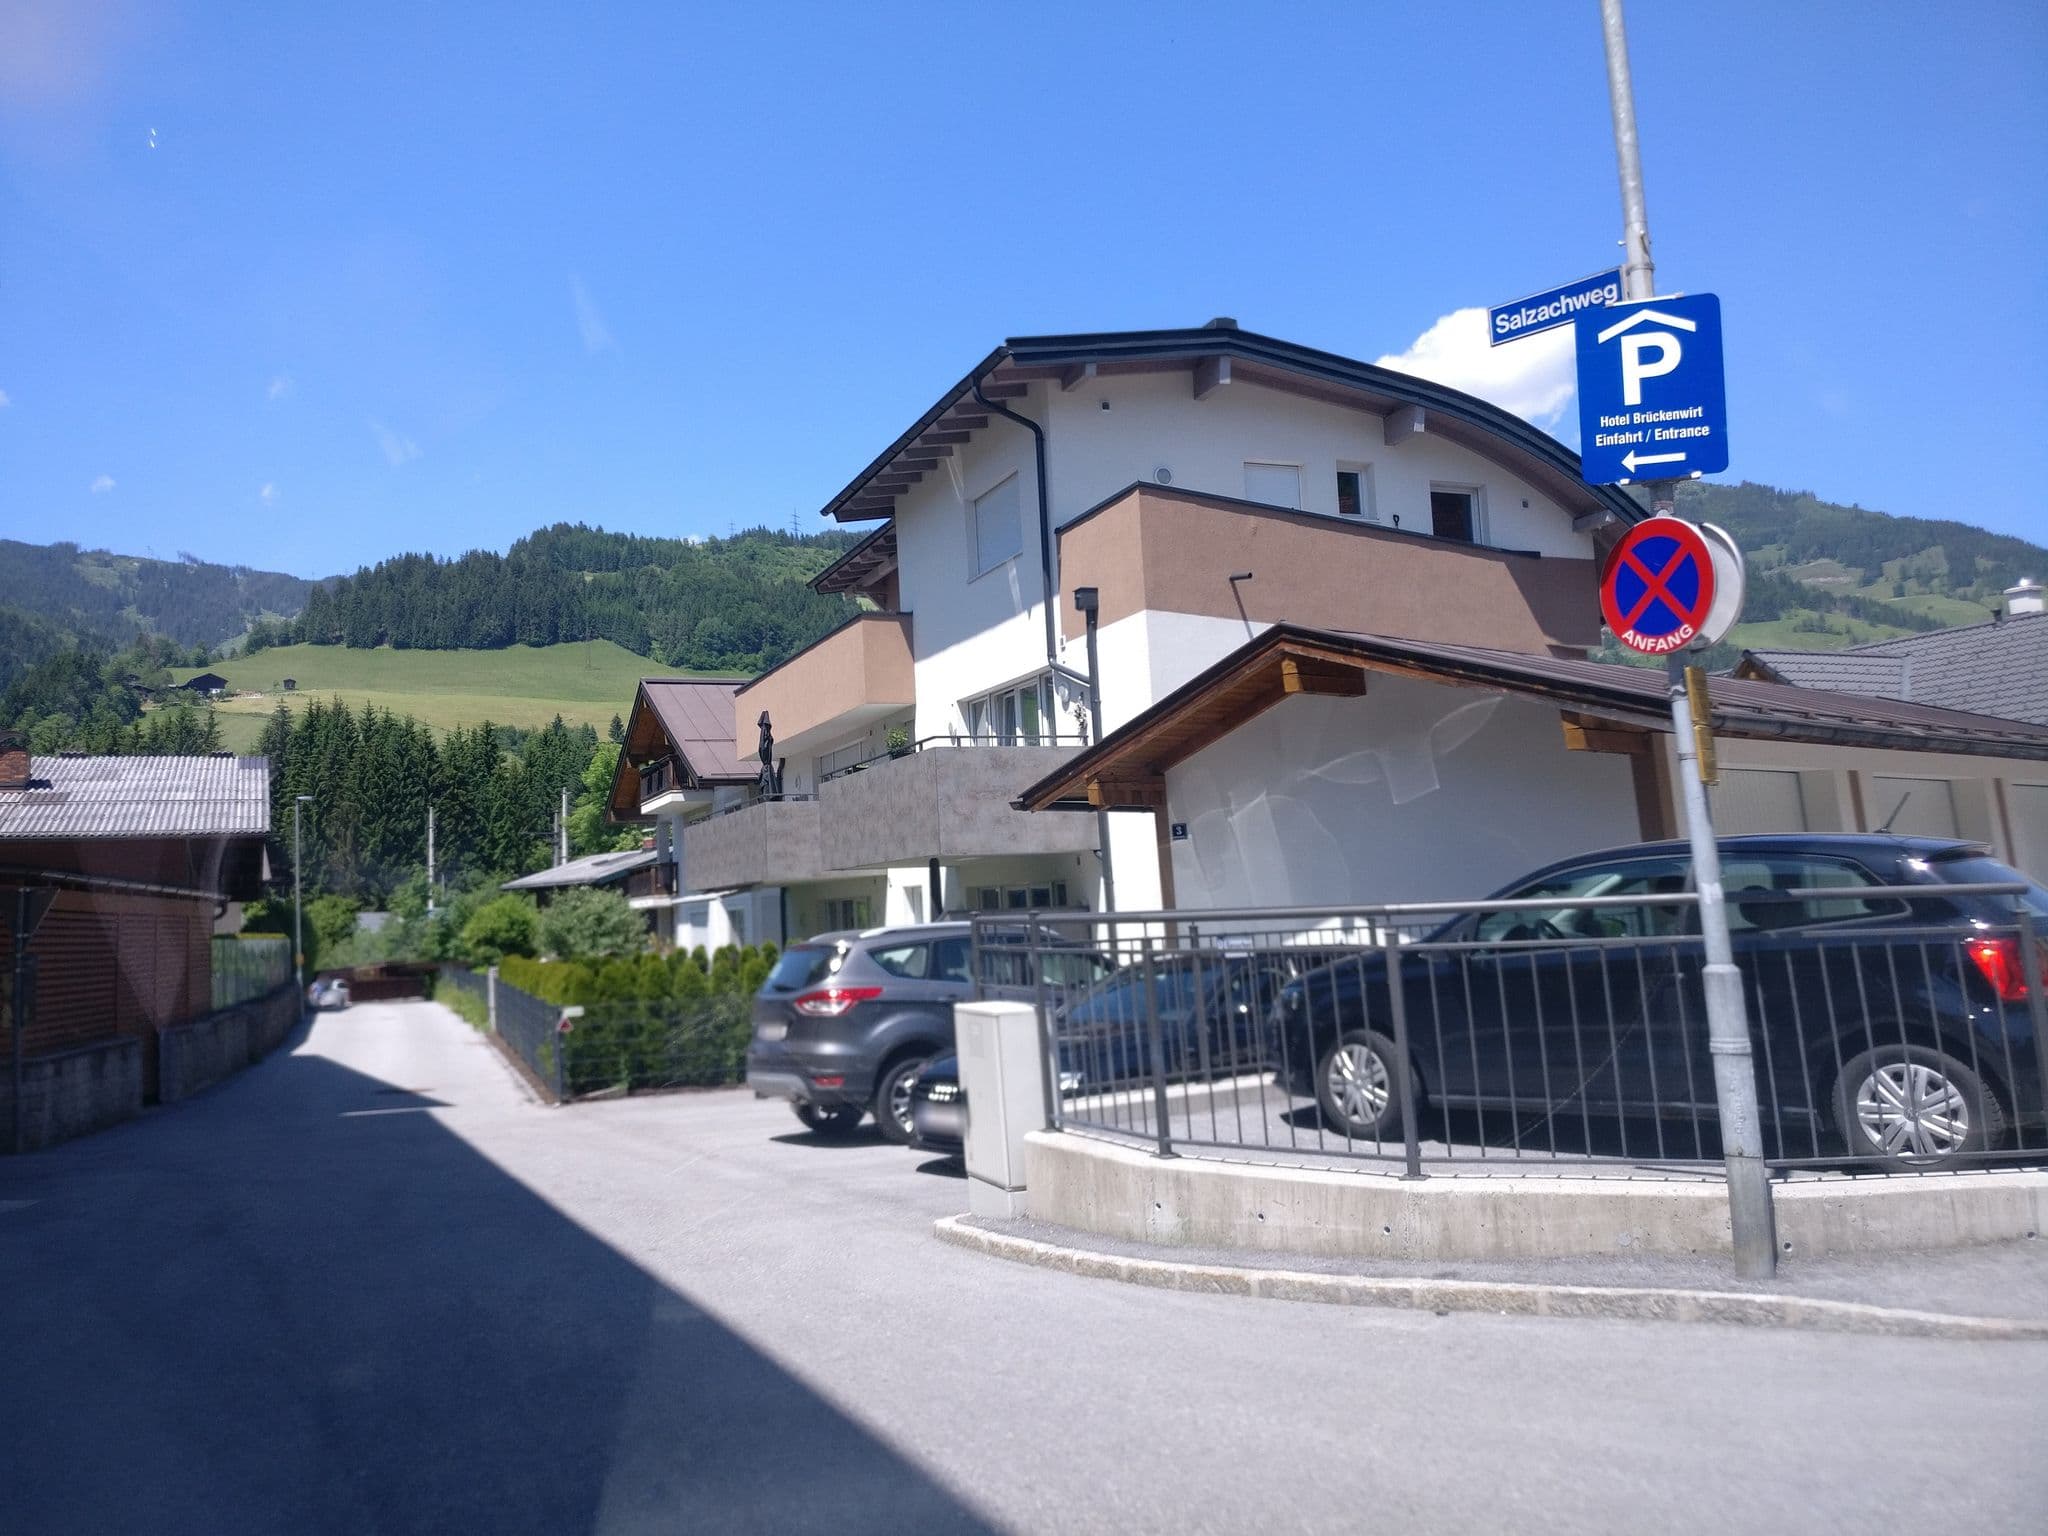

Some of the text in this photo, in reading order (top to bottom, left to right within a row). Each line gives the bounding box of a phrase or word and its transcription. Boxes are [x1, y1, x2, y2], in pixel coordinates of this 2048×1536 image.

[1495, 283, 1618, 334] Salzachweg
[1620, 331, 1682, 406] P
[1600, 406, 1703, 428] Hotel Brückenwirt
[1595, 425, 1710, 447] Einfahrt / Entrance
[1621, 623, 1694, 652] ANFANG
